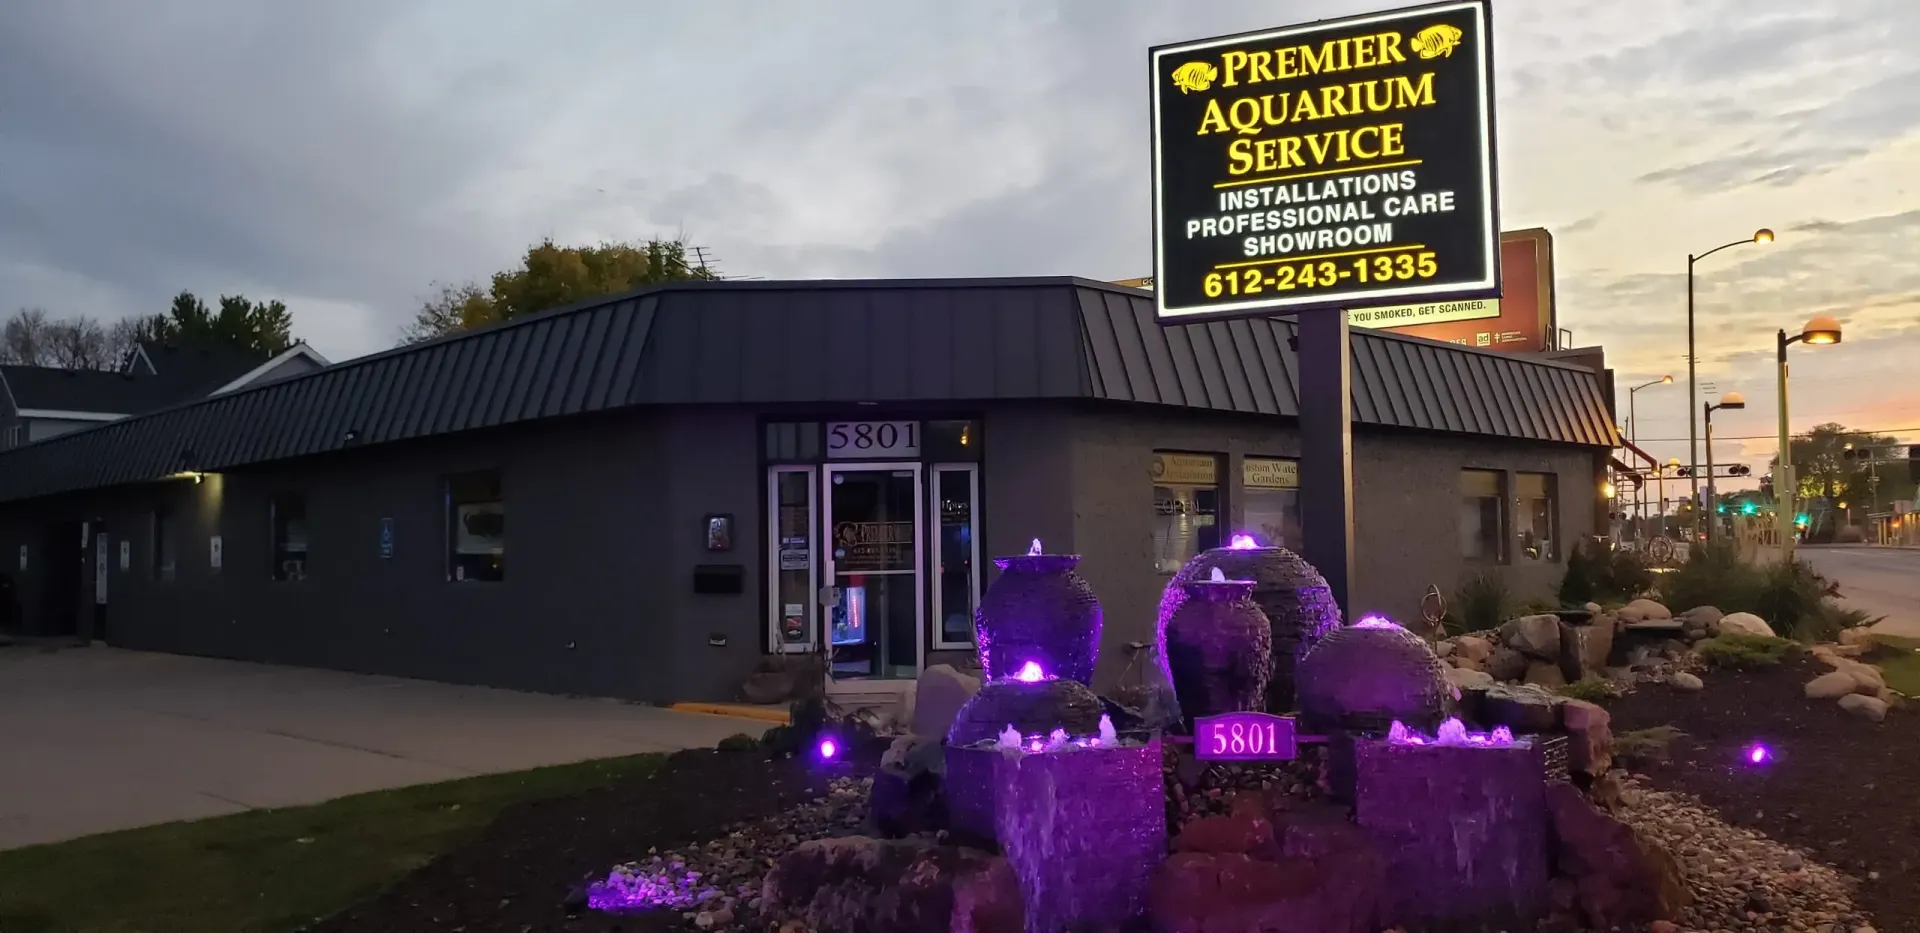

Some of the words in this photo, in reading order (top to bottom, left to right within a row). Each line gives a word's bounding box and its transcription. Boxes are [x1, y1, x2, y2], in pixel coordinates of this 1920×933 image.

[1221, 31, 1406, 88] PREMIER
[1197, 73, 1436, 135] AQUARIUM
[1228, 123, 1405, 175] SERVICE
[1219, 170, 1417, 211] INSTALLATIONS
[1186, 201, 1376, 239] PROFESSIONAL
[1384, 191, 1456, 217] CARE
[1243, 223, 1393, 256] SHOWROOM
[1203, 252, 1438, 298] 612-243-1335
[1353, 312, 1372, 322] YOU
[1374, 308, 1416, 320] SMOKED,
[1418, 305, 1436, 316] GET
[1439, 301, 1486, 313] SCANNED.
[830, 423, 916, 449] 5801
[1251, 472, 1290, 485] Gardens
[1213, 723, 1277, 754] 5801
